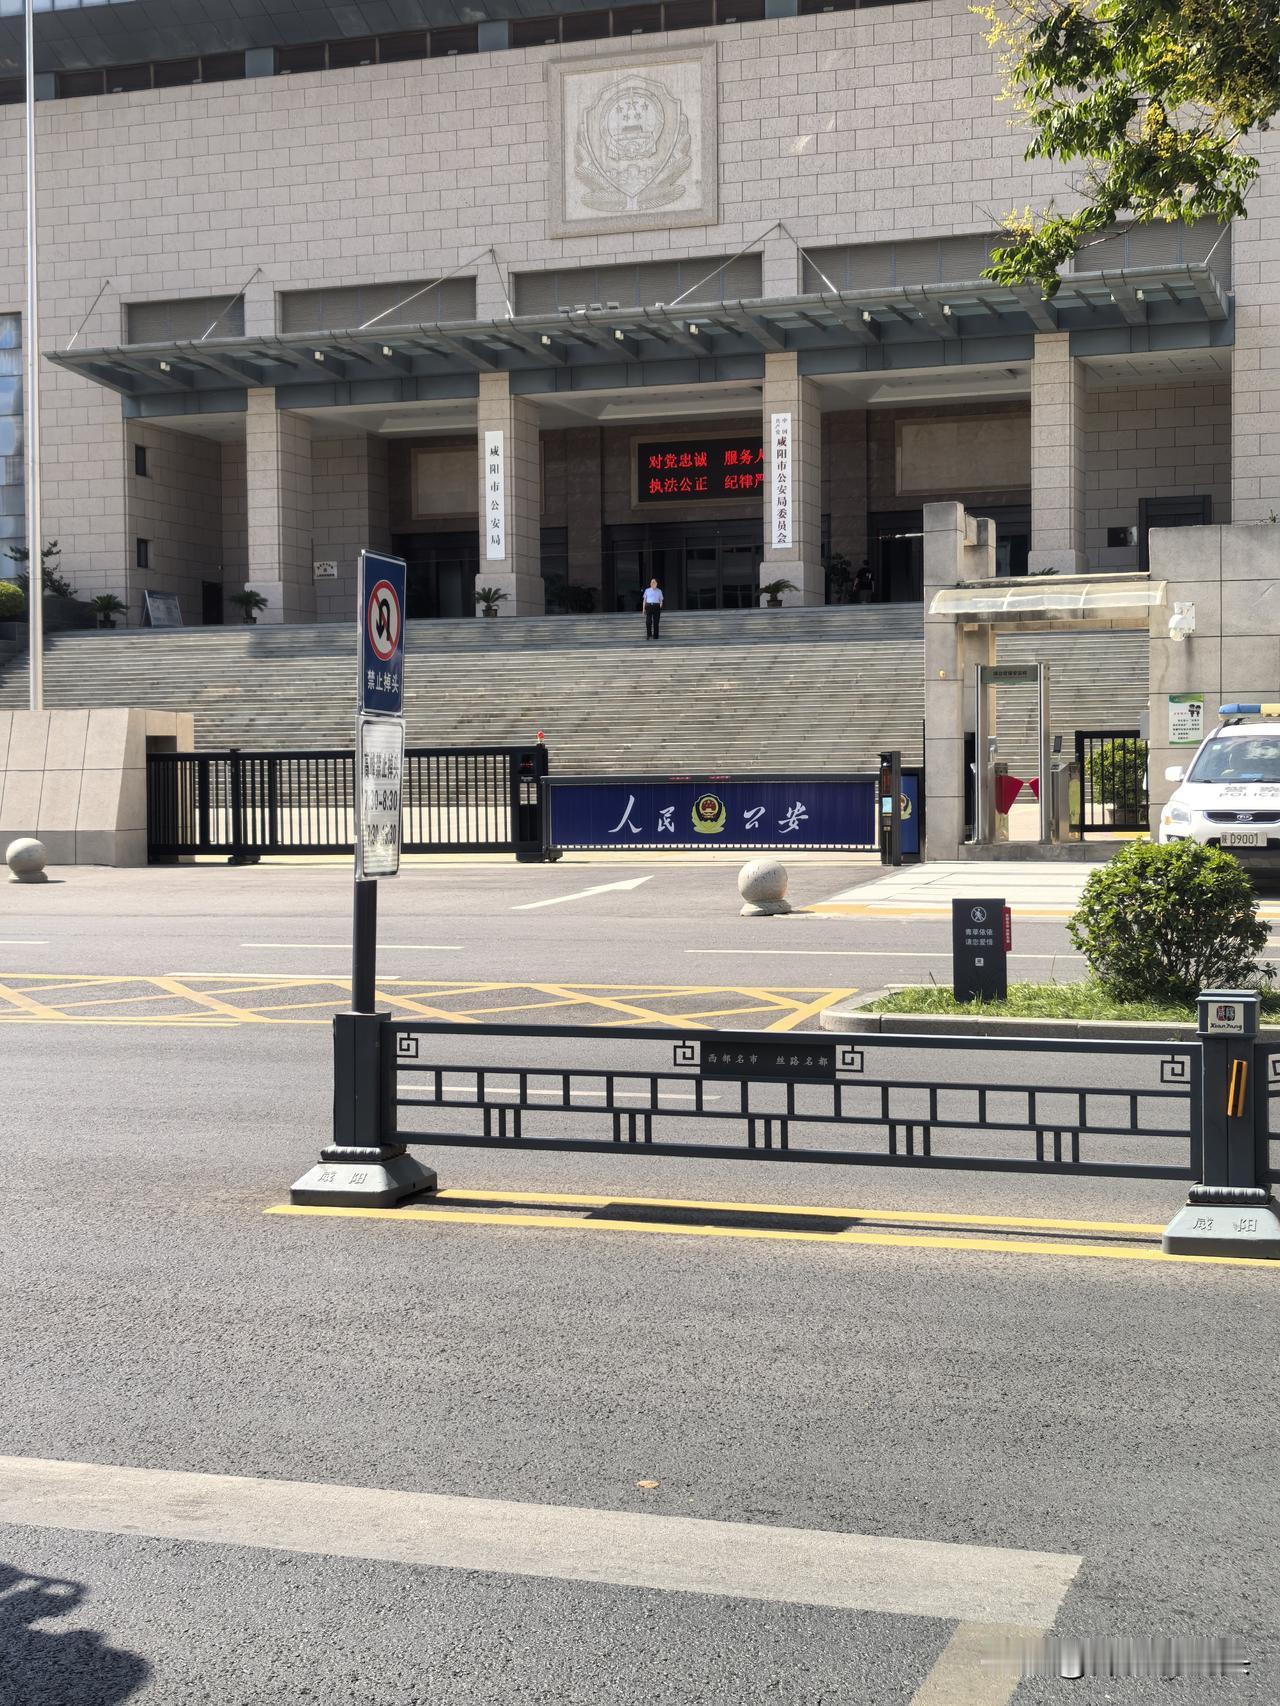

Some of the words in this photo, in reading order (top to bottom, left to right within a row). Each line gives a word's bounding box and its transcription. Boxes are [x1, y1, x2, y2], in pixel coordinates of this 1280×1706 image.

[648, 451, 708, 470] 对党忠诚
[648, 476, 709, 494] 执法公正
[776, 436, 788, 544] 咸阳市公安局委员会
[489, 445, 501, 546] 咸阳市公安局
[367, 670, 400, 694] 禁止掉头
[608, 794, 676, 834] 人民
[743, 801, 809, 834] 公安
[708, 1053, 758, 1065] 西部名市
[775, 1056, 829, 1068] 丝路名都
[317, 1171, 369, 1185] 咸阳
[1192, 1217, 1258, 1233] 咸阳
